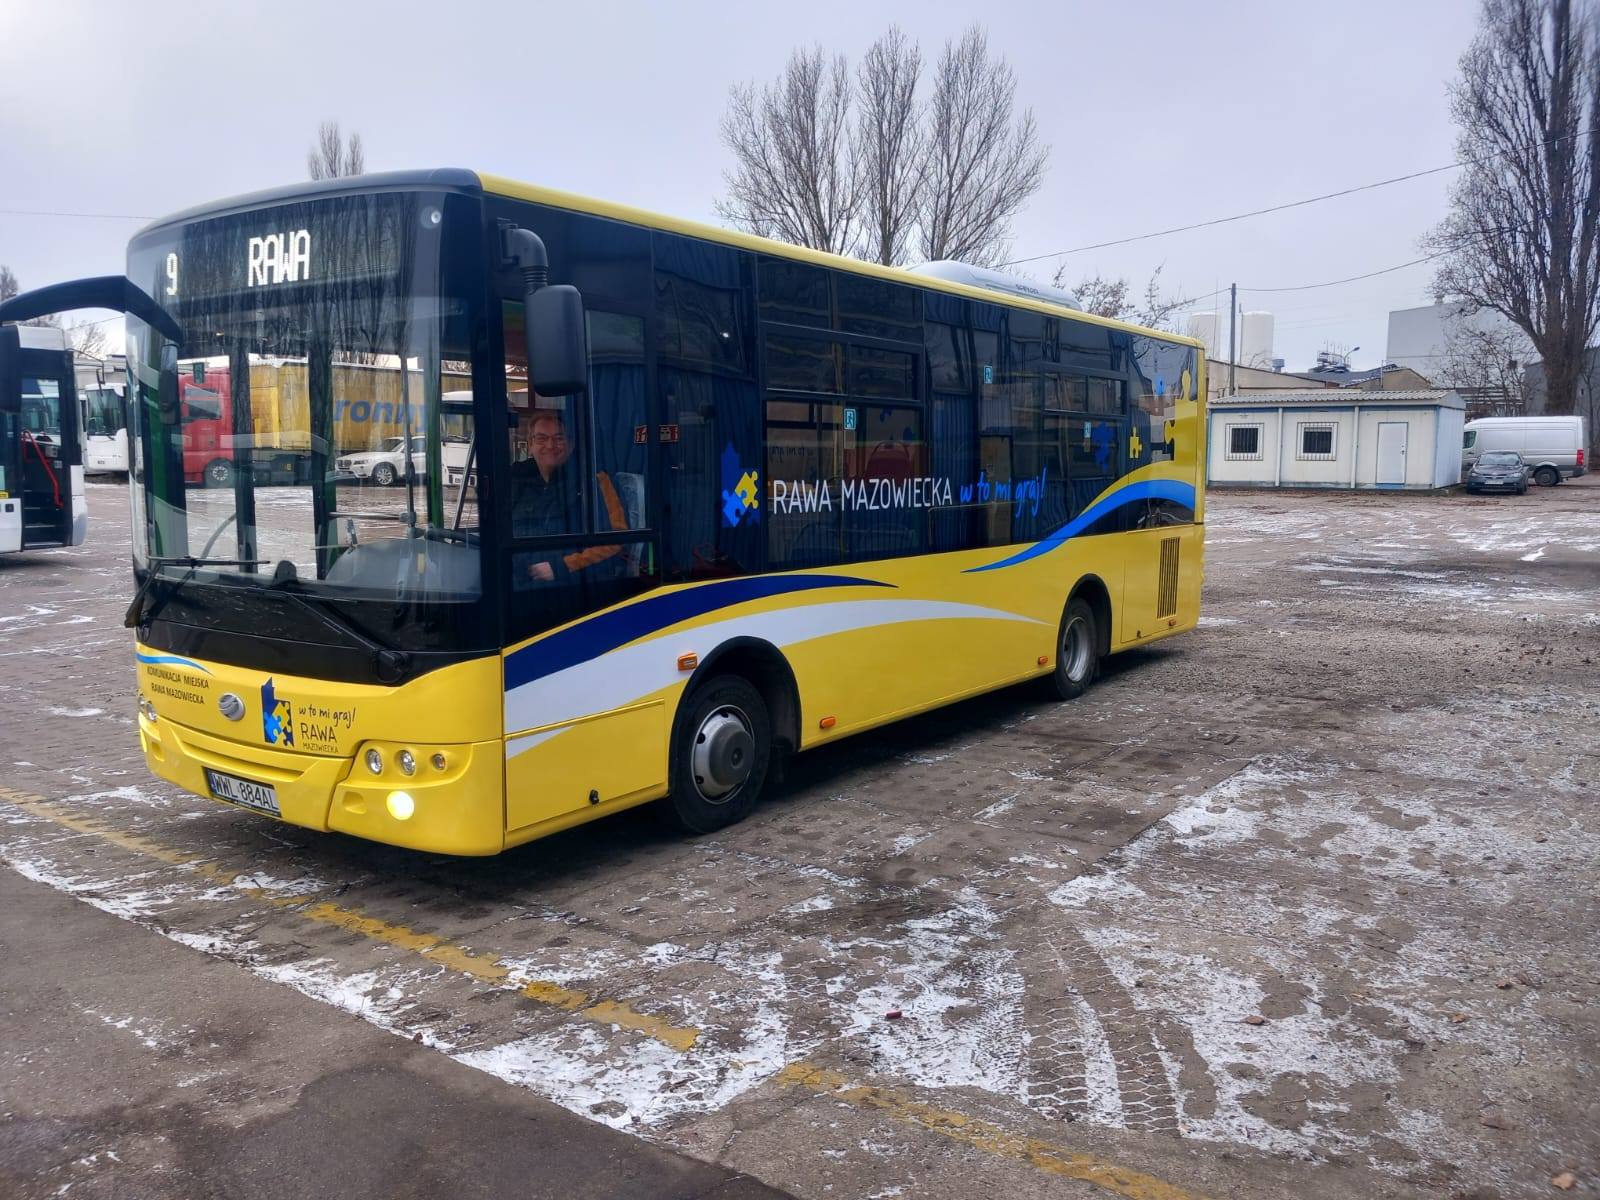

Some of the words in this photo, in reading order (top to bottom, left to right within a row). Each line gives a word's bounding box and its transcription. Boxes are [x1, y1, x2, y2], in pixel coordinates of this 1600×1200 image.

[166, 252, 178, 296] 9
[248, 229, 311, 287] RAWA
[773, 479, 832, 515] RAWA
[841, 477, 952, 512] MAZOWIECKA
[960, 484, 973, 503] w
[977, 471, 991, 503] to
[1015, 466, 1047, 518] graj!
[151, 682, 166, 695] RAWA
[166, 686, 205, 705] MAZOWIECKA
[183, 675, 209, 689] MIEJSKA
[299, 706, 306, 715] w
[308, 704, 317, 717] to
[319, 708, 330, 719] mi
[333, 706, 356, 729] graj!
[300, 722, 338, 744] RAWA
[303, 741, 339, 753] MAZOWIECKA
[214, 774, 238, 798] WWL
[239, 782, 279, 810] 884AL
